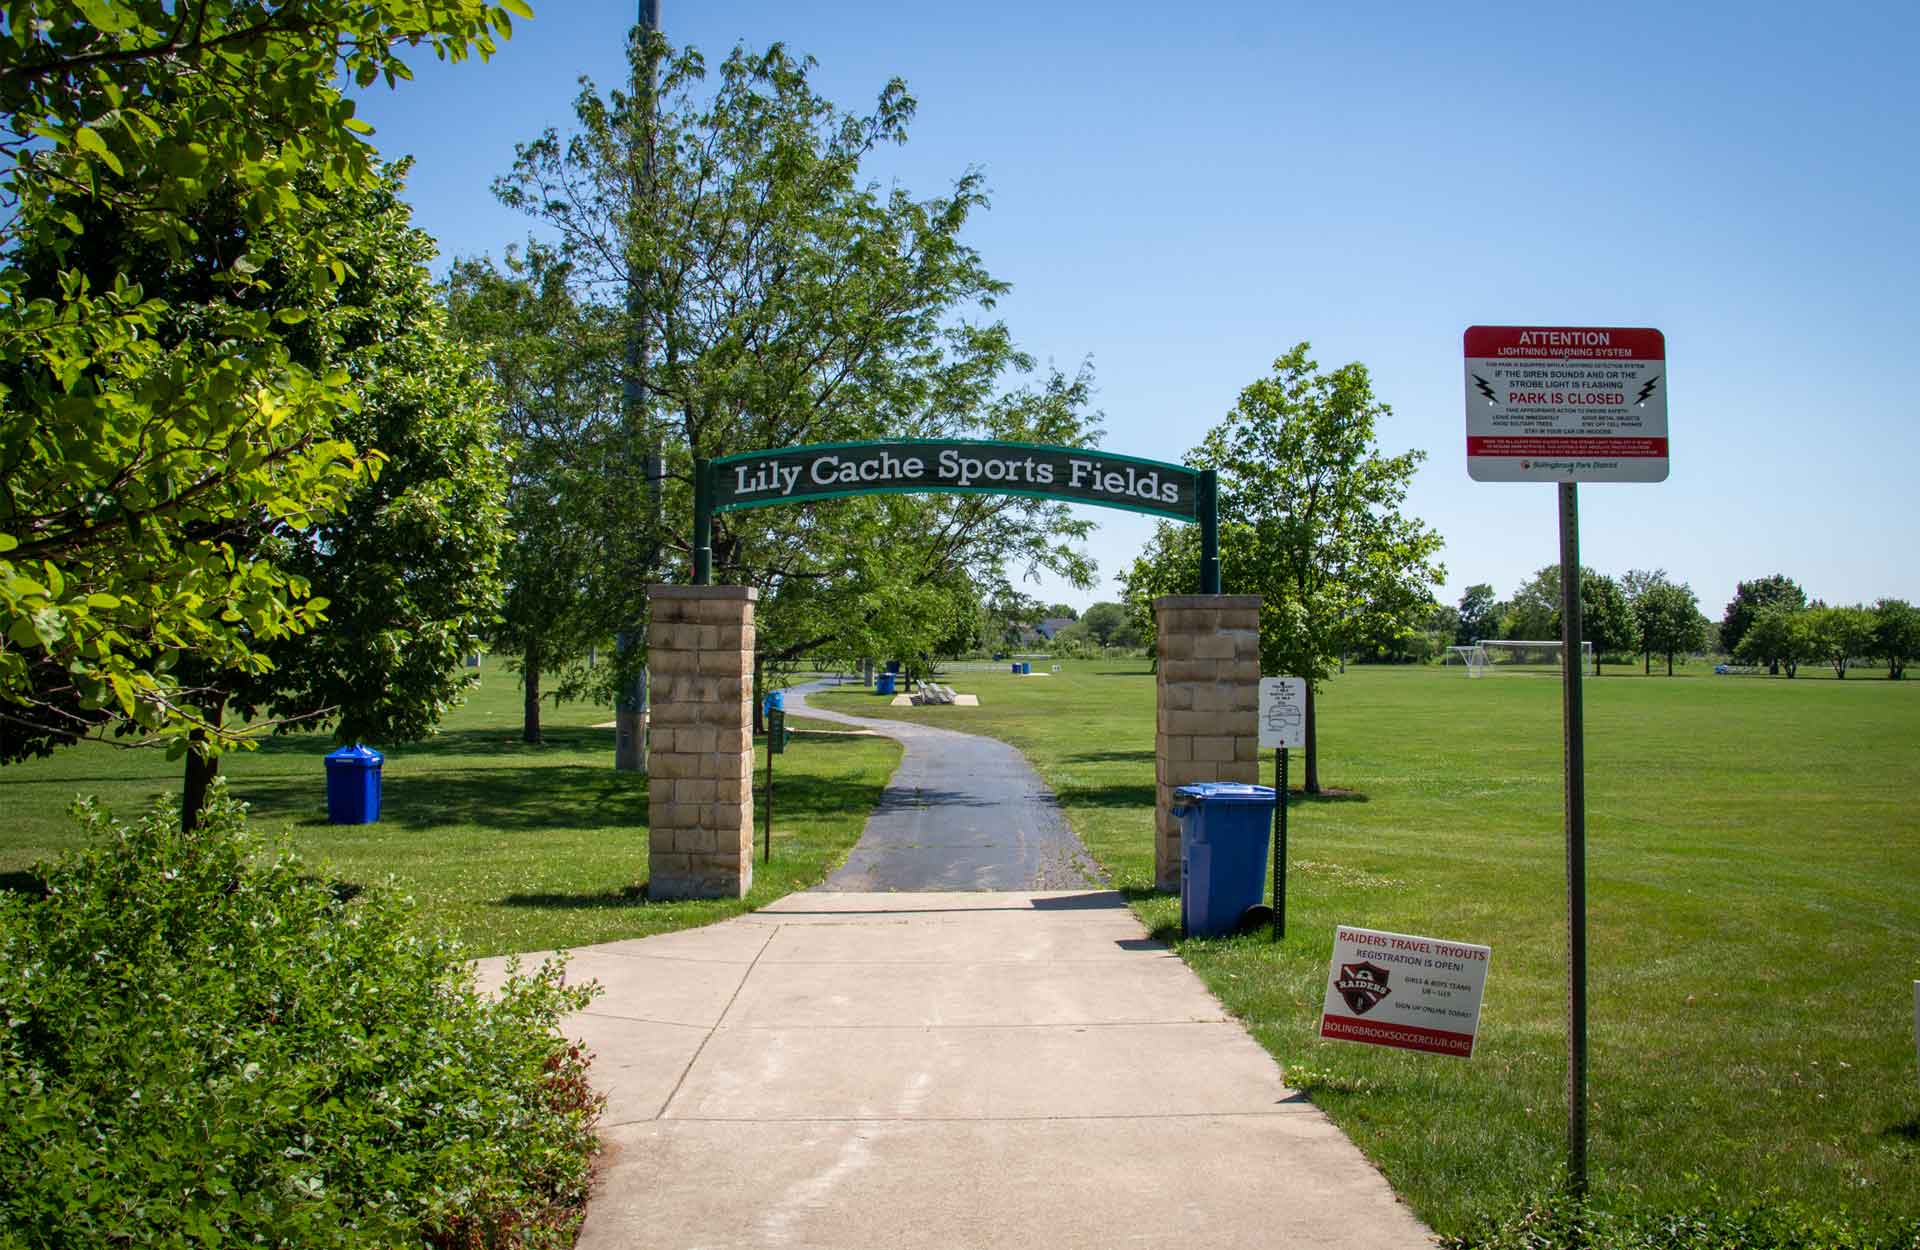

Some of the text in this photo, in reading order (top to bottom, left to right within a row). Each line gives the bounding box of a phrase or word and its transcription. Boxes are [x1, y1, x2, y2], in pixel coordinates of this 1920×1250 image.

[1520, 332, 1610, 346] ATTENTION
[1498, 348, 1632, 357] LIGHTNING WARNING SYSTEM
[1586, 371, 1604, 379] AND
[1606, 371, 1619, 379] OR
[1621, 371, 1637, 379] THE
[1545, 381, 1570, 389] LIGHT
[1572, 381, 1580, 389] IS
[1582, 381, 1624, 389] FLASHING
[1510, 393, 1624, 404] PARK IS CLOSED
[734, 450, 1180, 504] Lily Cache Sports Fields
[1340, 931, 1486, 961] RAIDERS TRAVEL TRYOUTS
[1356, 949, 1464, 972] REGISTRATION IS OPEN!
[1338, 980, 1387, 994] RAIDERS
[1324, 1021, 1470, 1050] BOLINGBROOKSOCCERCLUB.ORG
